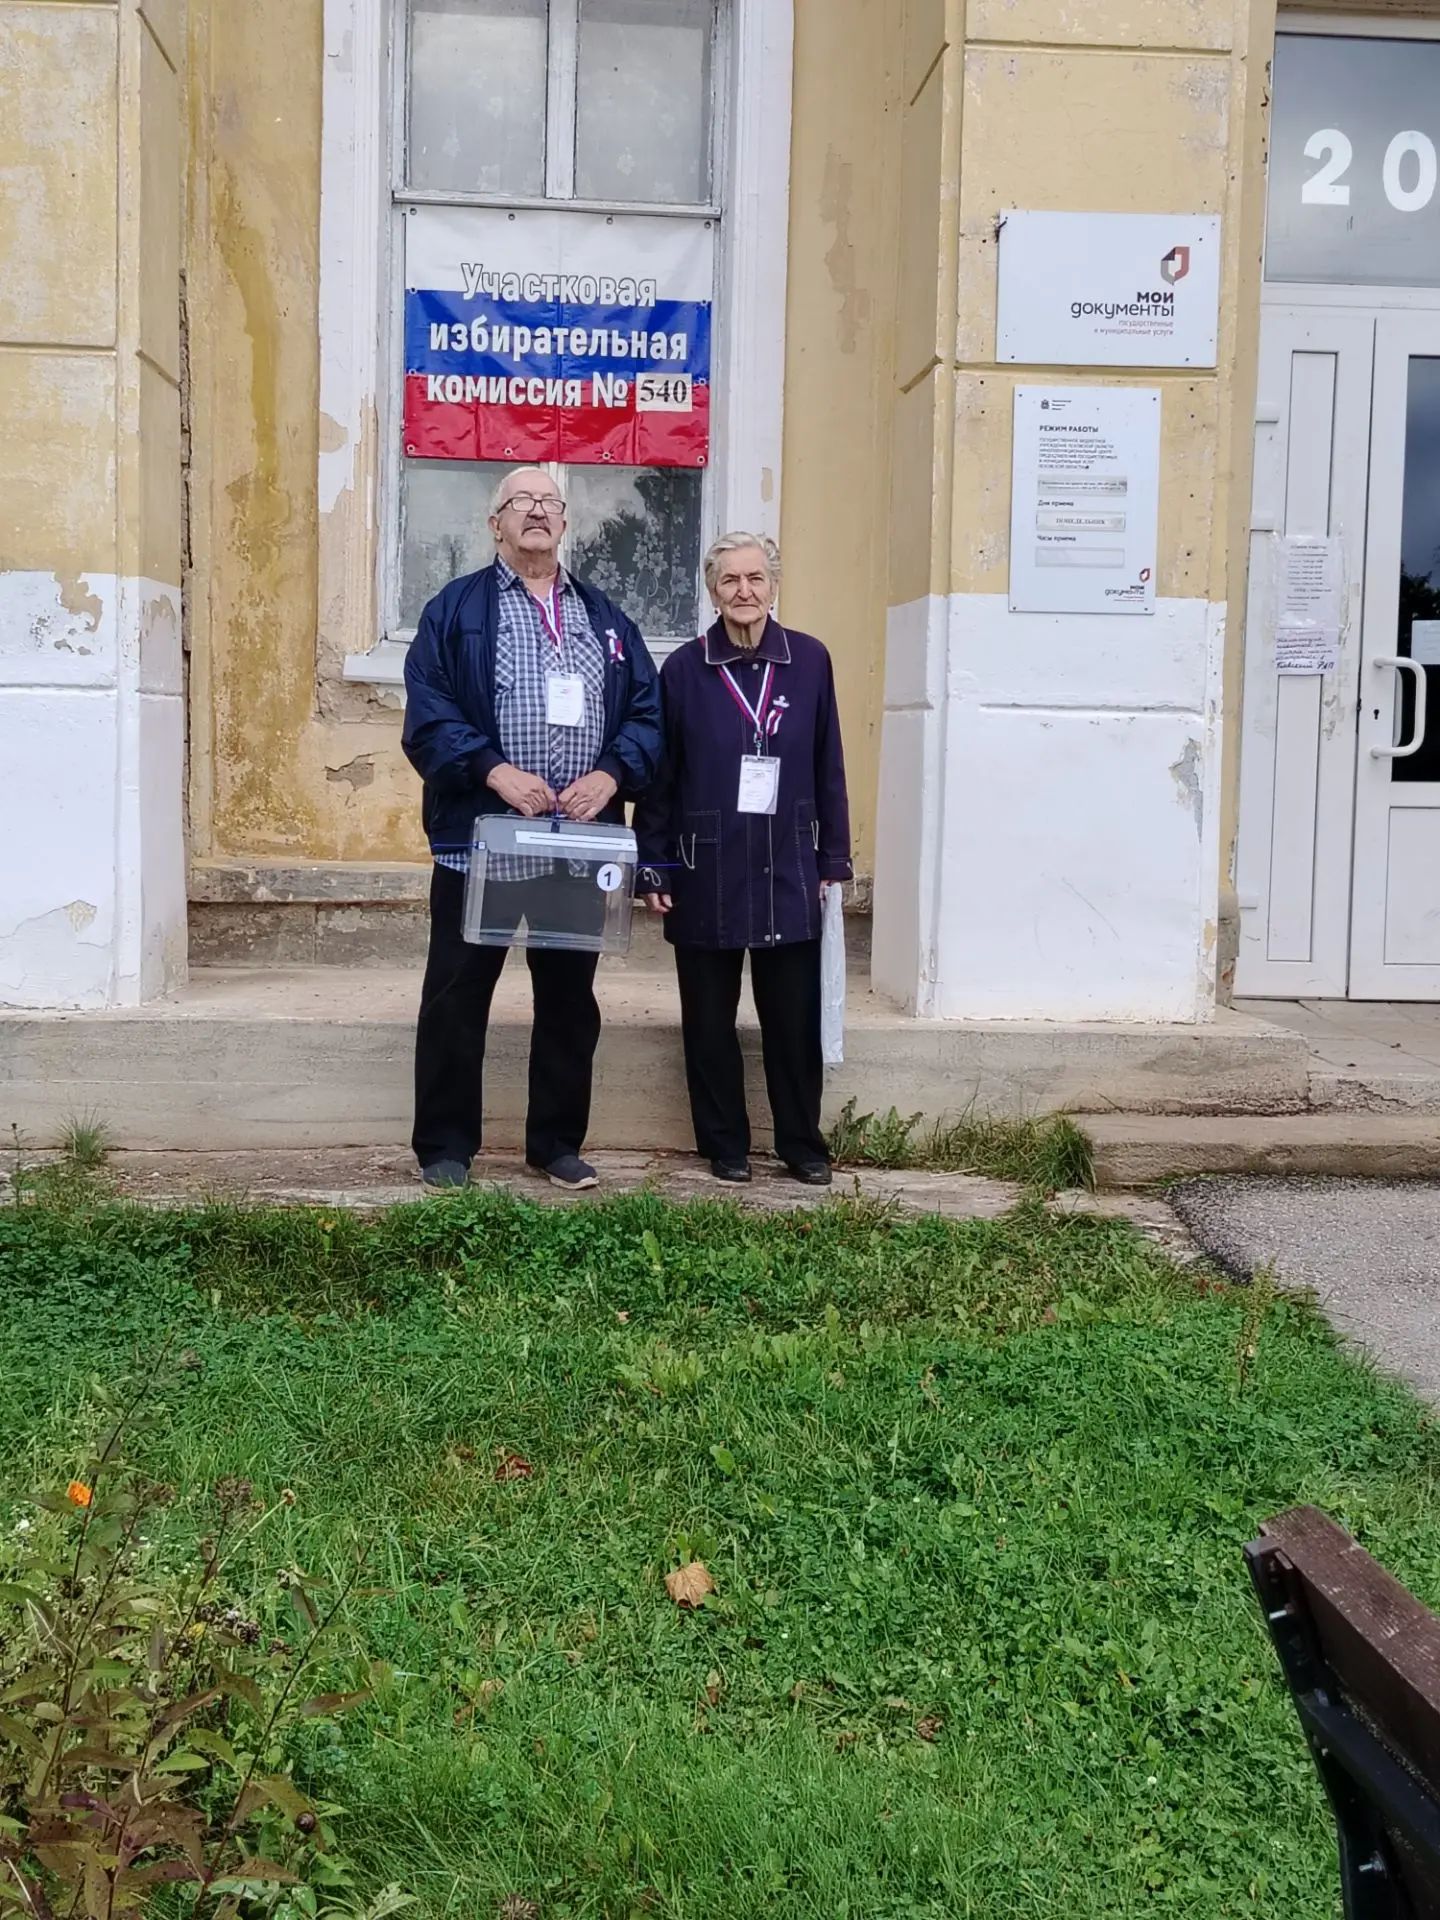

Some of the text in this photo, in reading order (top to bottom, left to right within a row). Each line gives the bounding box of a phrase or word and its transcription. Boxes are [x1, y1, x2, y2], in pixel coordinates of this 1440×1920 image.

[460, 262, 657, 308] Участковая
[1136, 291, 1174, 304] мои
[1070, 301, 1174, 319] документы
[429, 314, 688, 362] избирательная
[426, 371, 688, 408] комиссия № 540
[1068, 425, 1099, 433] РАБОТЫ
[603, 871, 612, 887] 1
